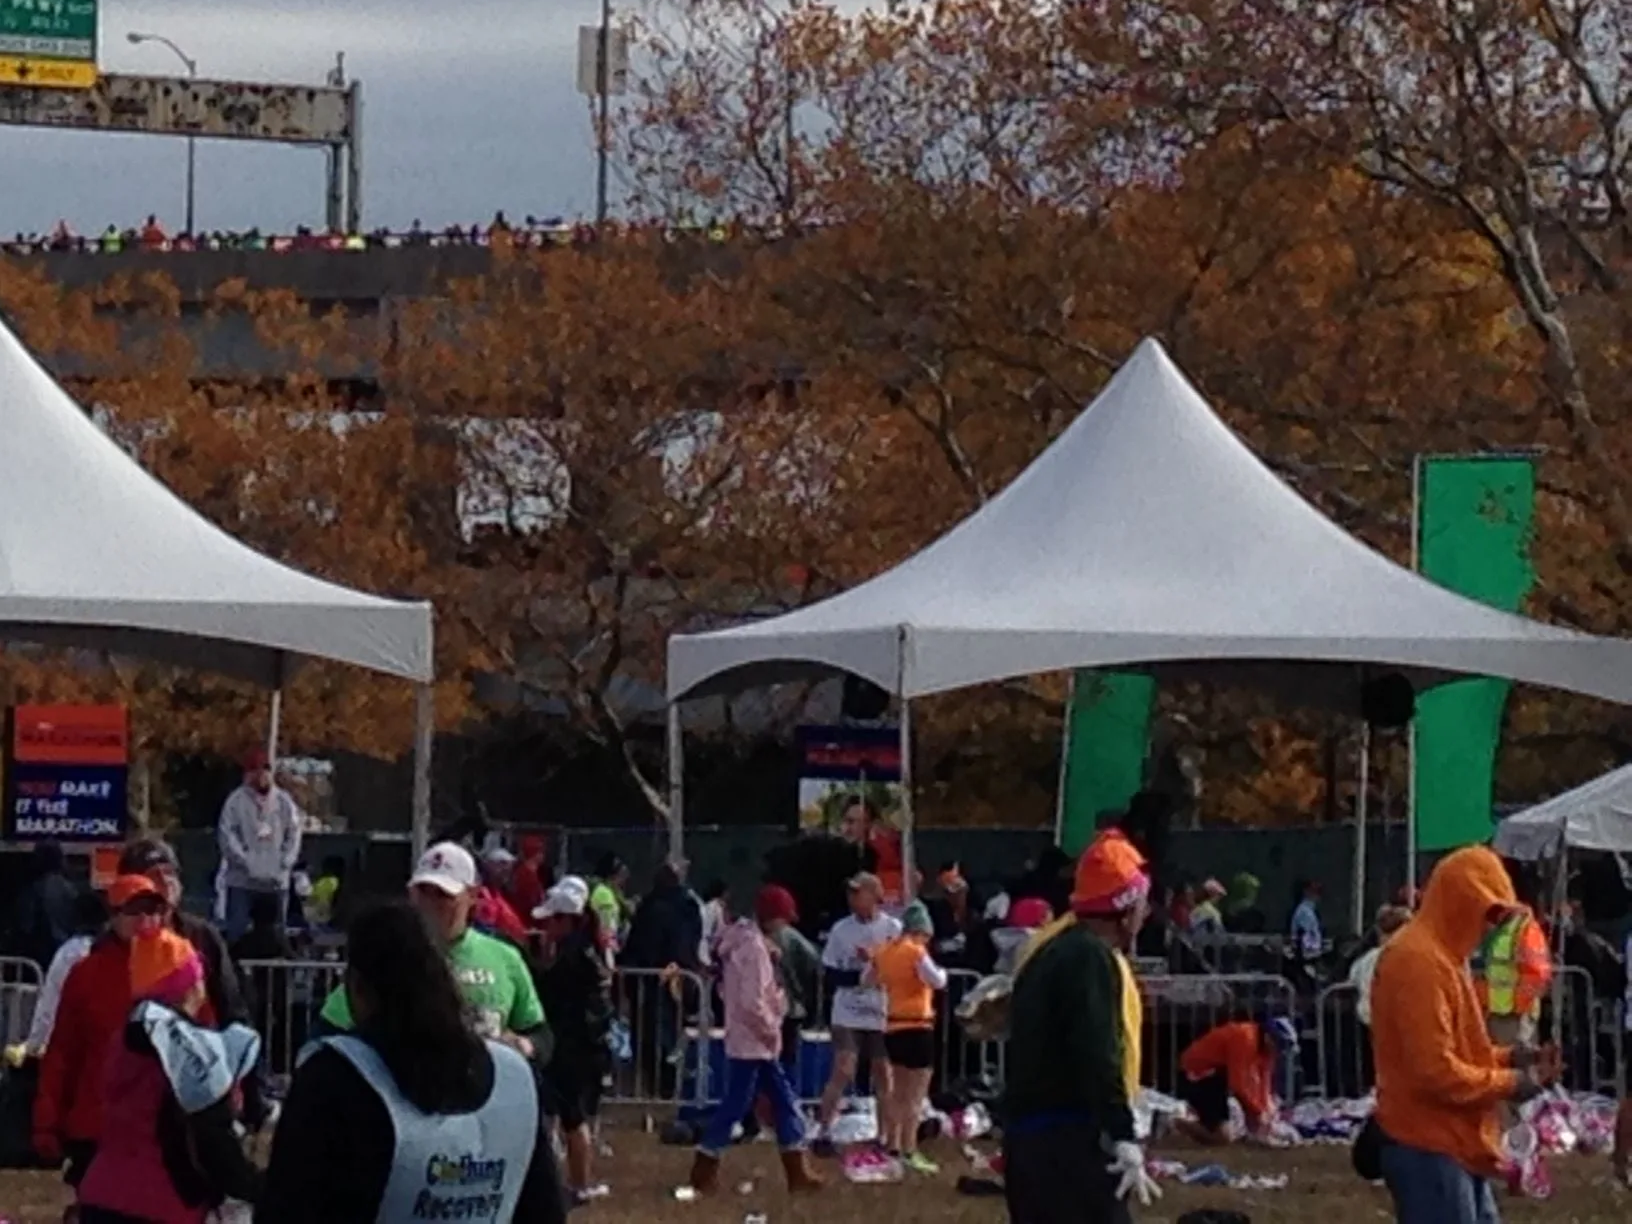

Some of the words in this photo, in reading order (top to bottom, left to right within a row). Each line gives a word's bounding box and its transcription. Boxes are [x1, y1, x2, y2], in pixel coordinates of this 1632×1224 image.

[59, 779, 112, 799] MAKE
[15, 797, 32, 815] IT
[35, 797, 70, 816] THE
[426, 1152, 507, 1190] Clothing
[412, 1188, 505, 1224] Recovery
